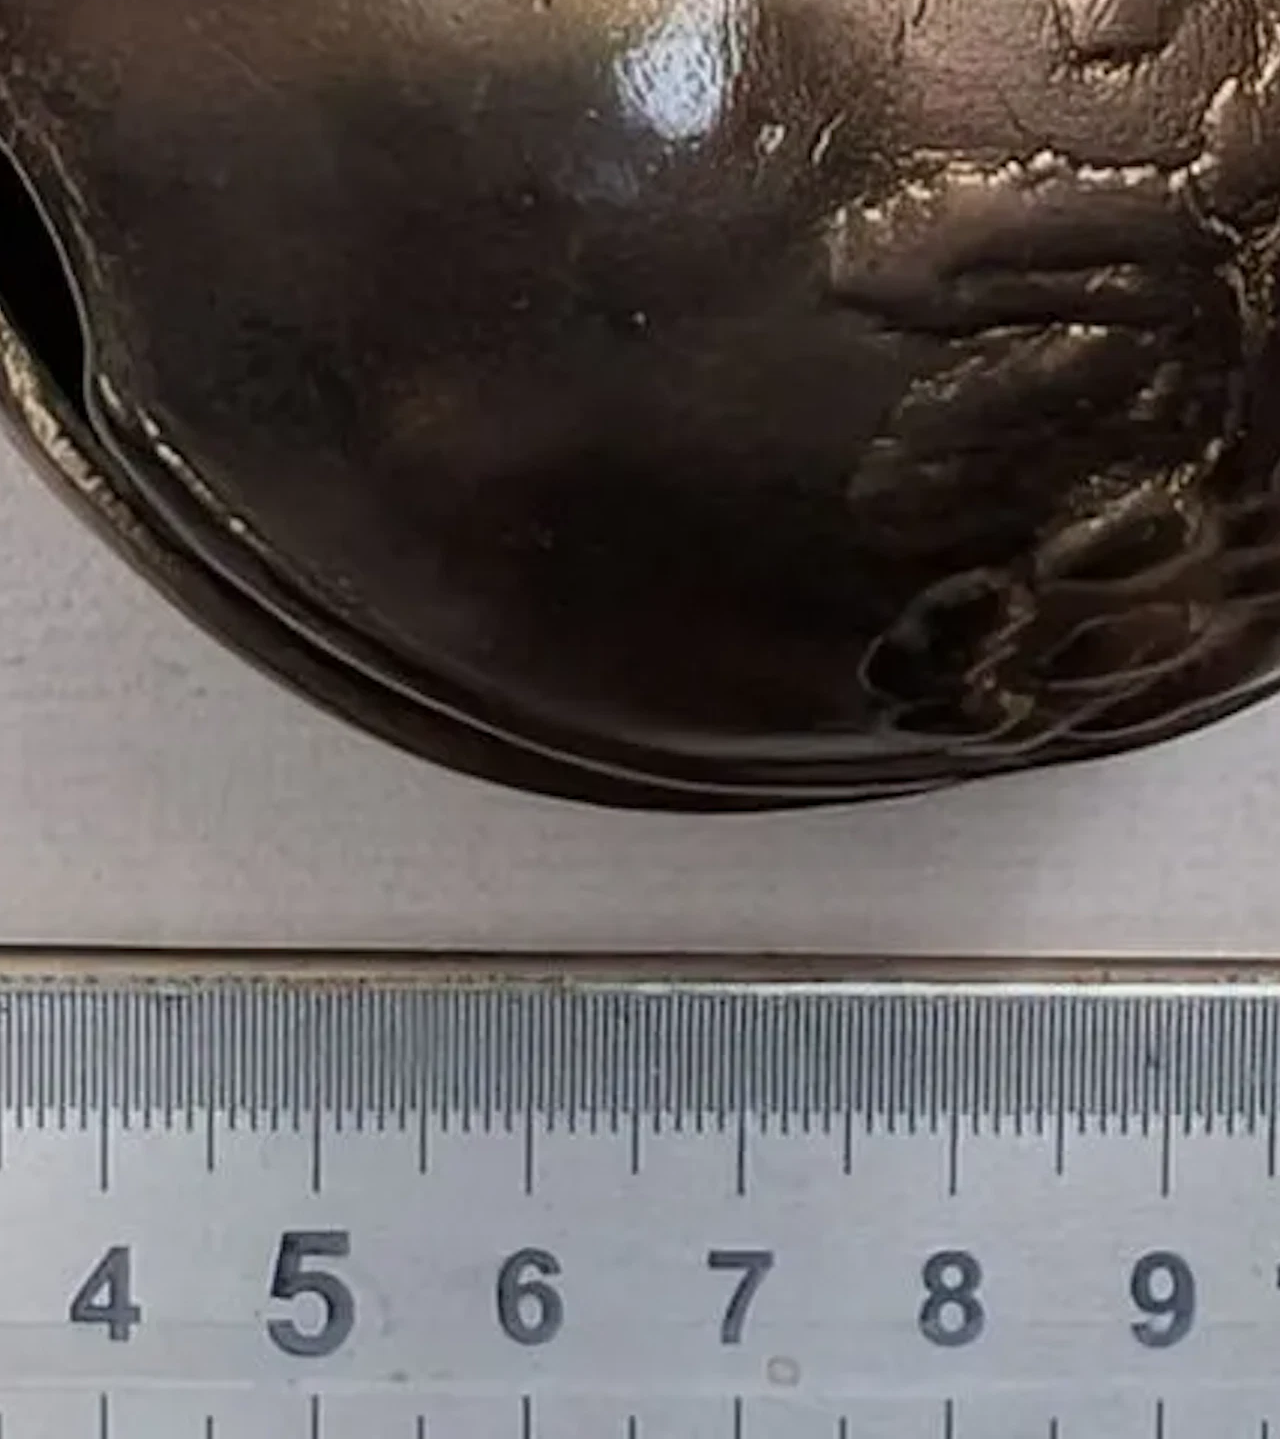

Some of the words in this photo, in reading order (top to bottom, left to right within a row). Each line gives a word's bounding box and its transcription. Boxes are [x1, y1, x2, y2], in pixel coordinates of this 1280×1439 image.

[69, 1246, 141, 1343] 4
[266, 1229, 356, 1359] 5
[494, 1246, 564, 1347] 6
[706, 1250, 775, 1346] 7
[917, 1250, 985, 1348] 8
[1128, 1250, 1197, 1350] 9
